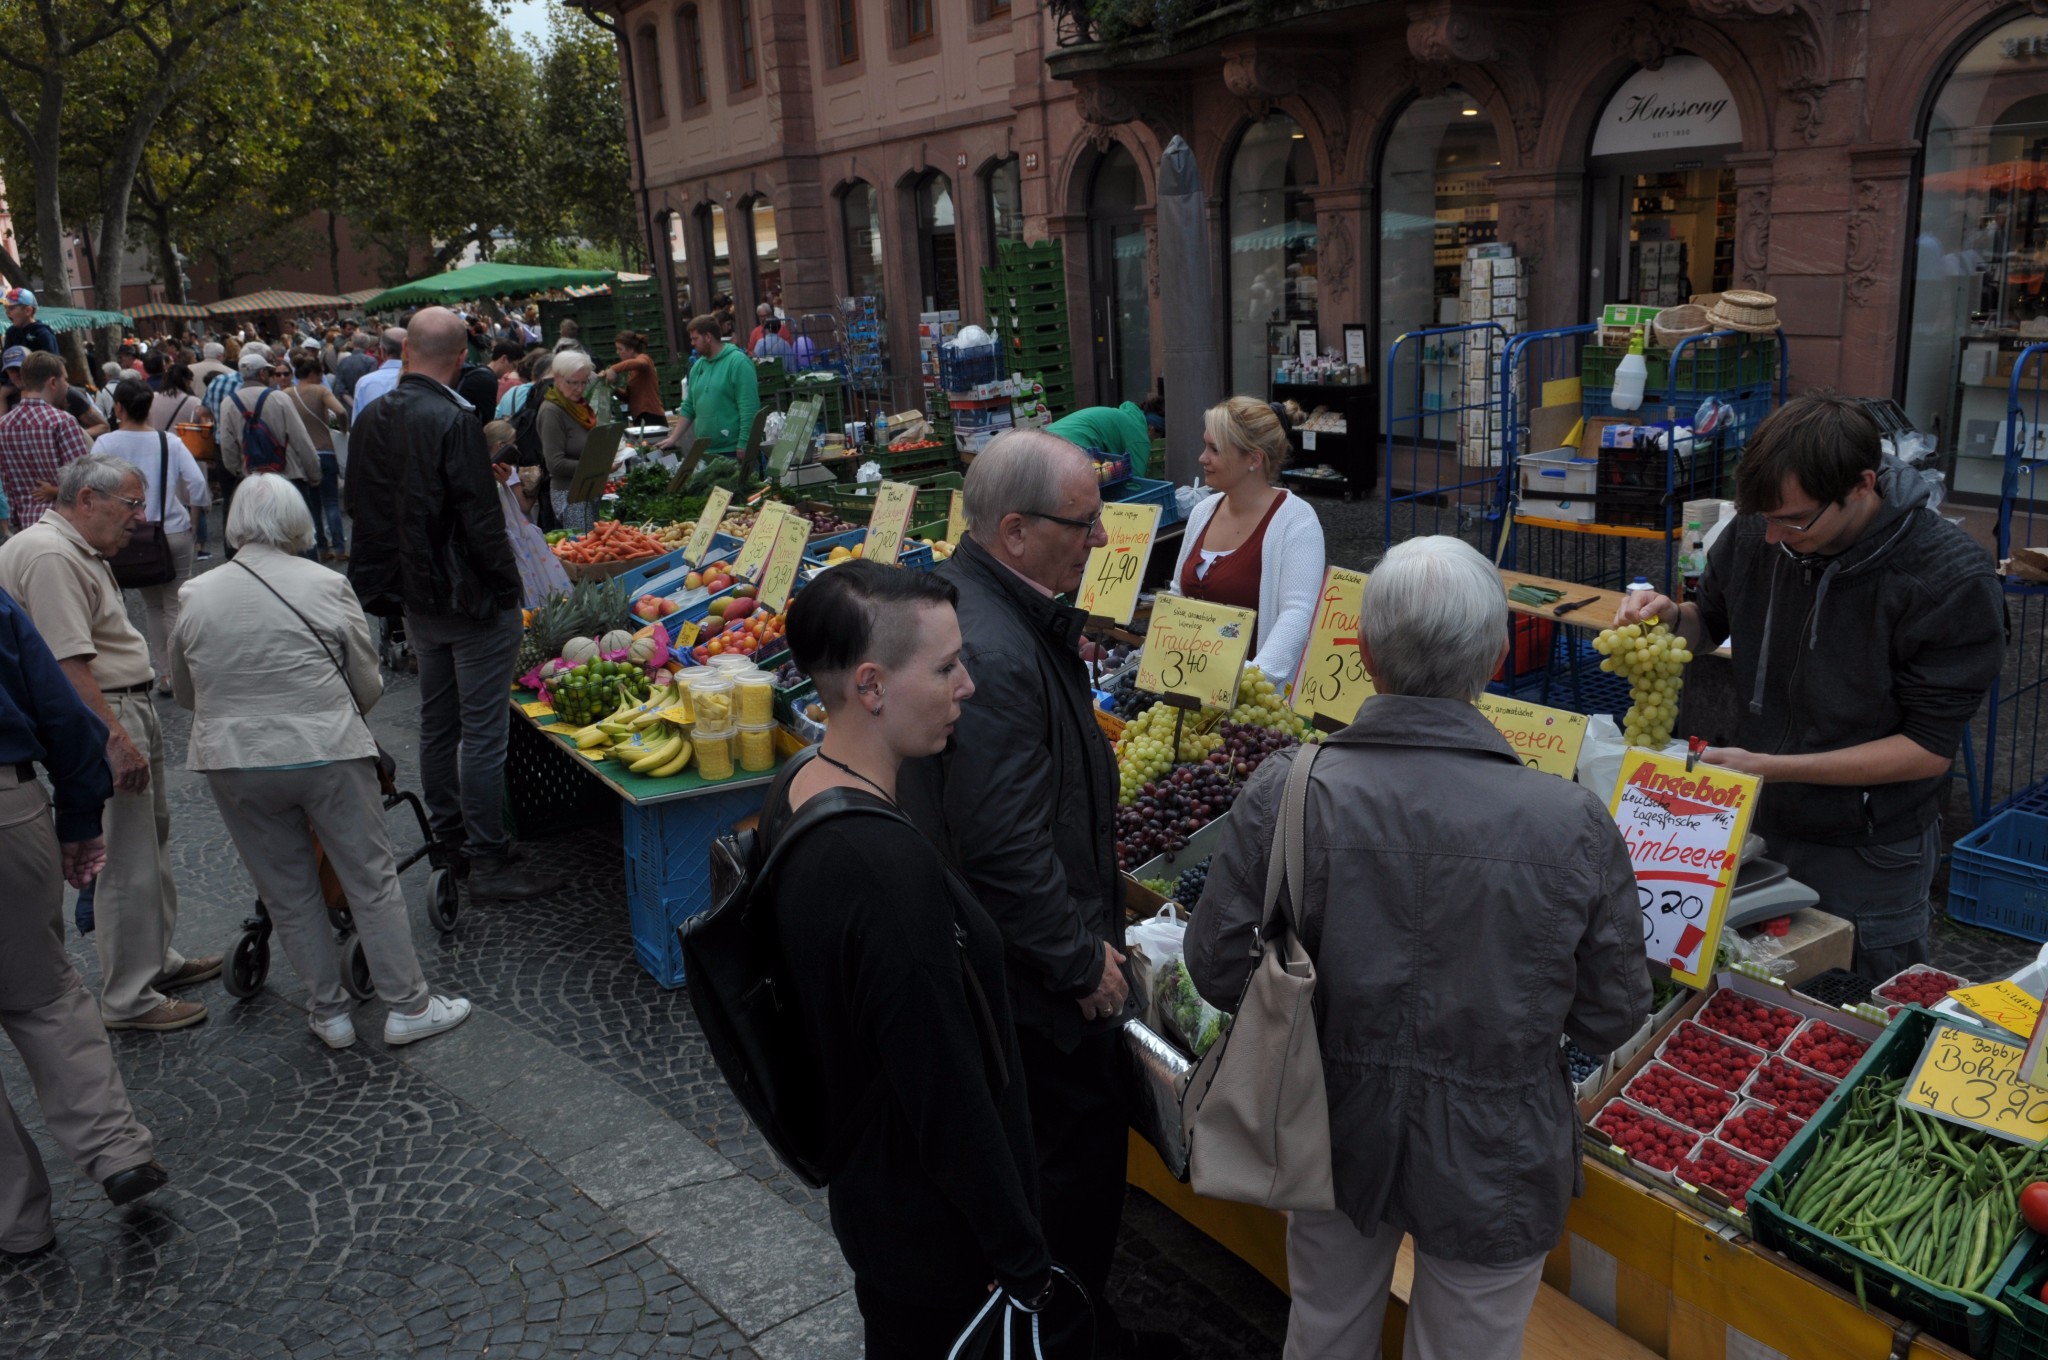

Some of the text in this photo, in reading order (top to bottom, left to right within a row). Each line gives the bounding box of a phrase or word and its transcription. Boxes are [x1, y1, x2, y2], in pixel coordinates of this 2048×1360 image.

[1618, 93, 1729, 124] Hussong
[1652, 131, 1669, 139] SEIT
[1333, 571, 1362, 585] deutsche
[1321, 585, 1360, 633] Trau
[1152, 615, 1224, 656] Trauben
[1494, 705, 1534, 718] aromatische
[1626, 760, 1747, 808] Angebot:
[1621, 787, 1671, 815] deutsche
[1633, 807, 1702, 831] tagesfrische
[1972, 1038, 2022, 1067] Bobby
